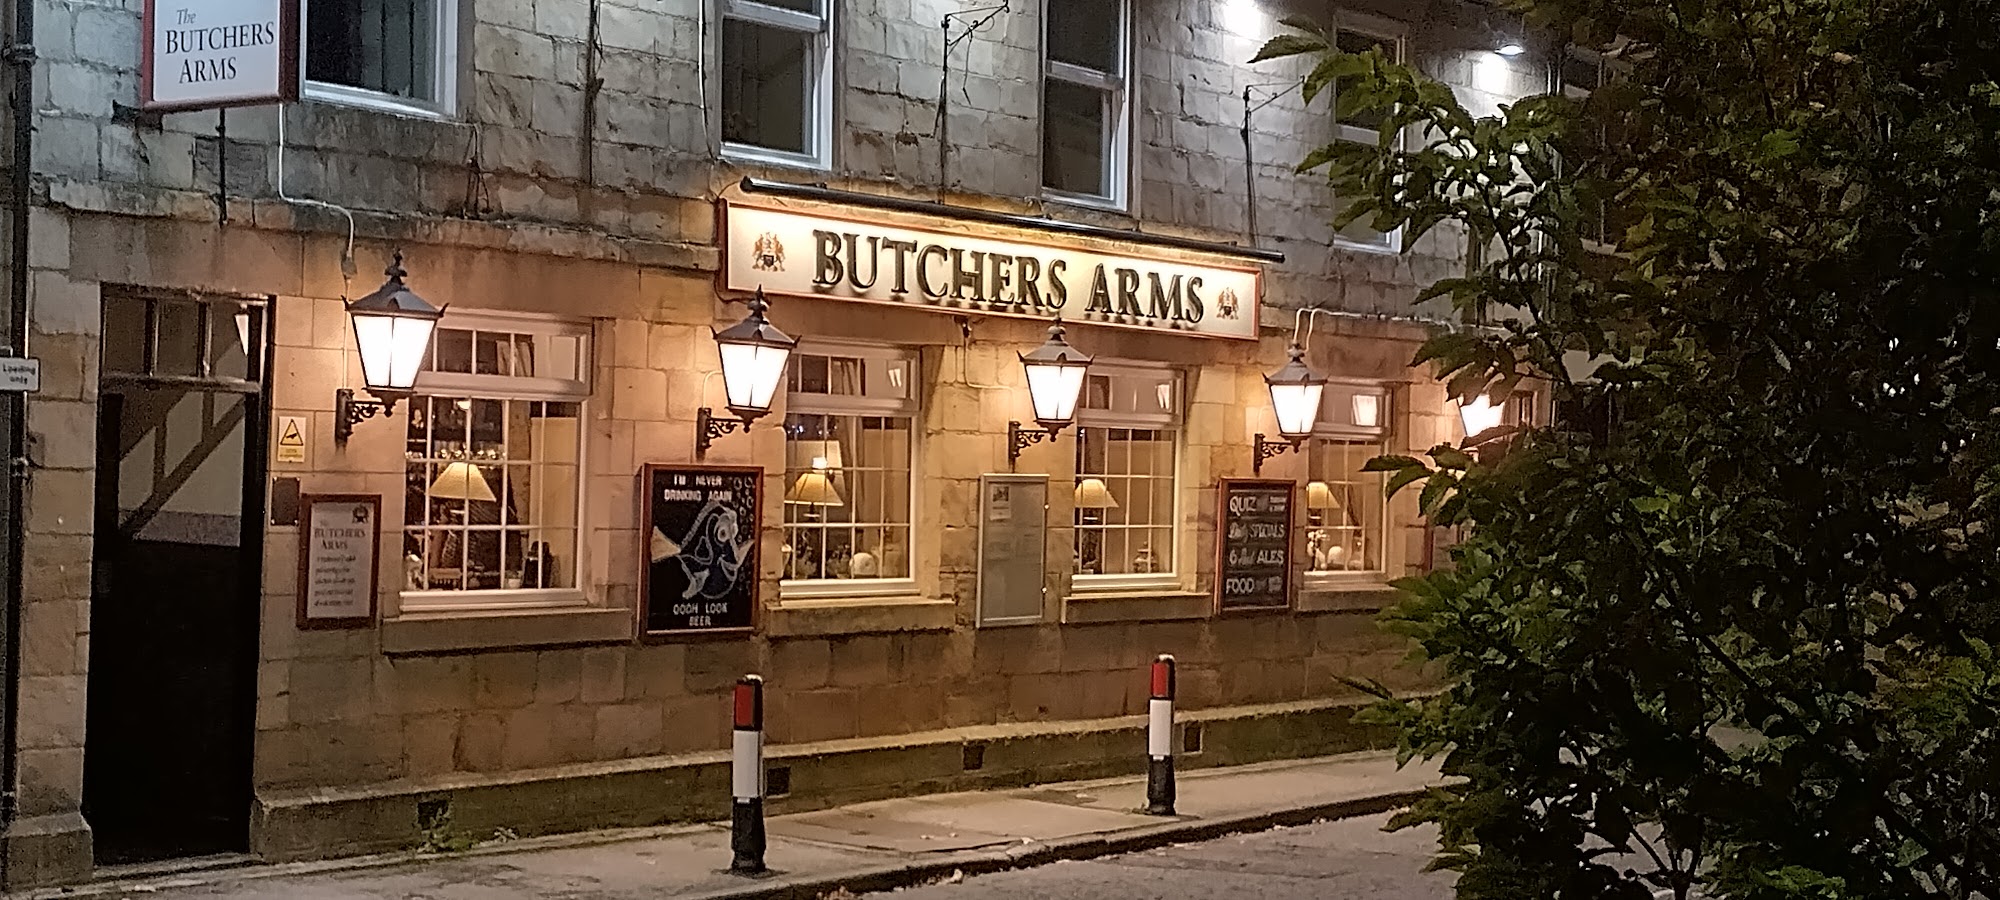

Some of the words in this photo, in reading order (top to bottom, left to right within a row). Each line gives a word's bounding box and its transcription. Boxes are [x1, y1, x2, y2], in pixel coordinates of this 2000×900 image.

[176, 8, 197, 25] The
[165, 21, 275, 55] BUTCHERS
[178, 56, 237, 84] ARMS
[812, 229, 1067, 310] BUTCHERS
[1084, 262, 1204, 324] ARMS
[695, 475, 722, 487] NEVER
[664, 489, 702, 502] DRINKING
[708, 490, 733, 502] AGAIN
[1229, 495, 1257, 516] QUIZ
[1256, 550, 1284, 565] ALES
[1226, 577, 1255, 595] FOOD
[673, 602, 699, 616] OOOH
[705, 602, 728, 614] LOOK
[689, 616, 712, 626] BEER
